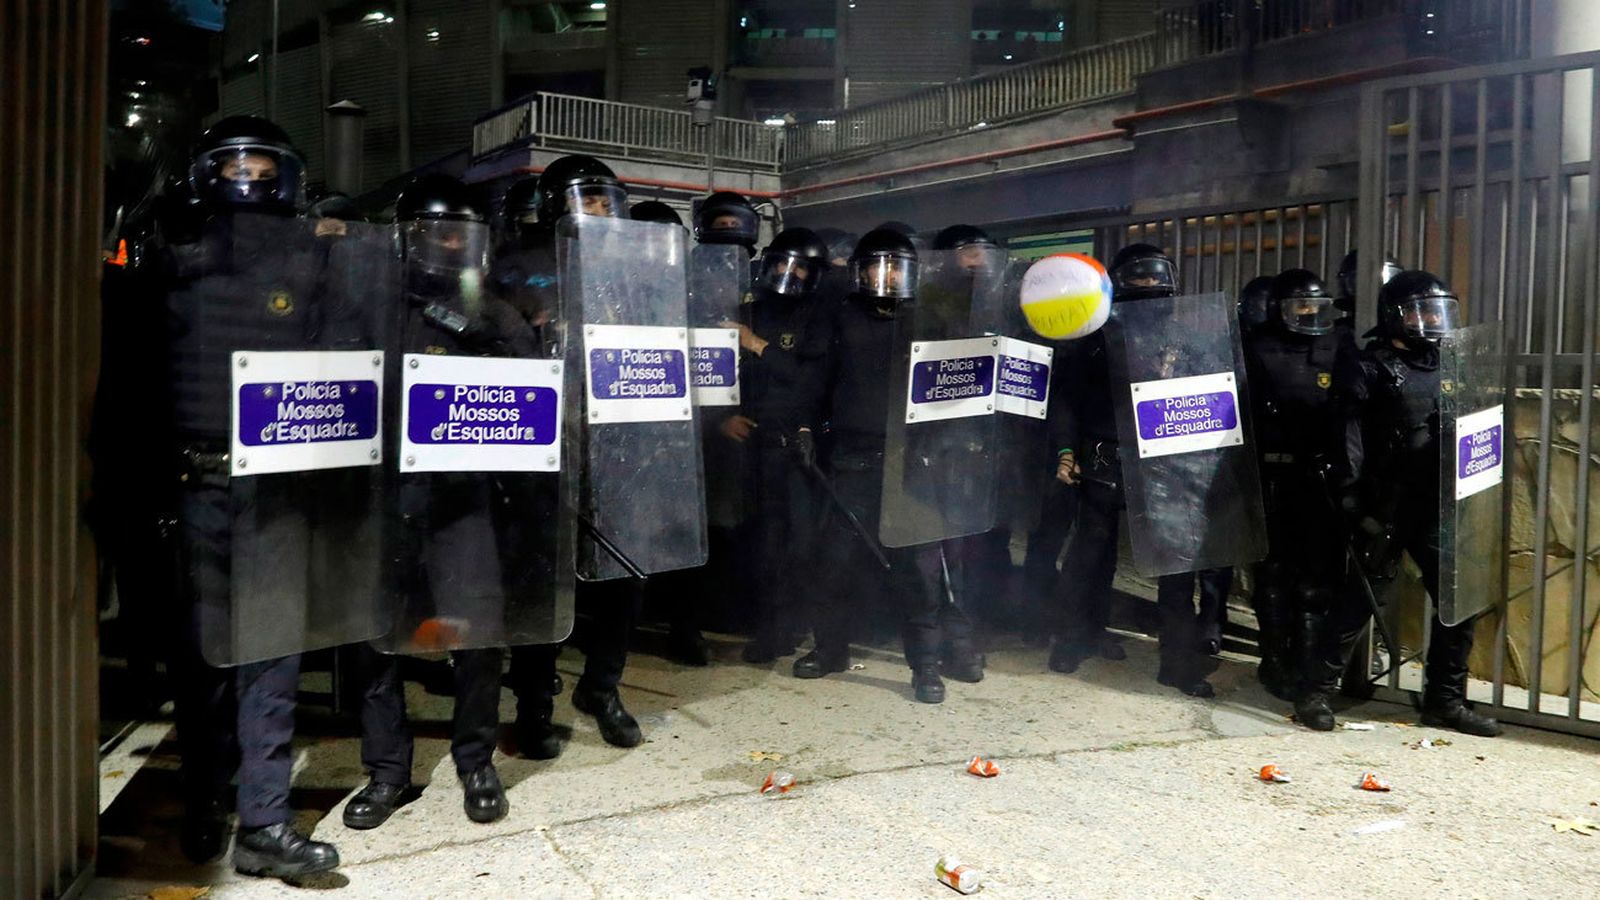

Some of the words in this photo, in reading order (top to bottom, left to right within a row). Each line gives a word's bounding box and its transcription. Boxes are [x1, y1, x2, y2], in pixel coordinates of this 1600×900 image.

[619, 364, 666, 381] Mossos
[936, 372, 976, 386] Mossos
[1001, 367, 1032, 385] Mossos
[277, 402, 345, 421] Mossos
[448, 403, 520, 422] Mossos
[1163, 408, 1212, 423] Mossos
[431, 422, 535, 445] d'Esquadra
[1155, 418, 1223, 436] d'Esquadra
[1471, 443, 1493, 459] Mossos
